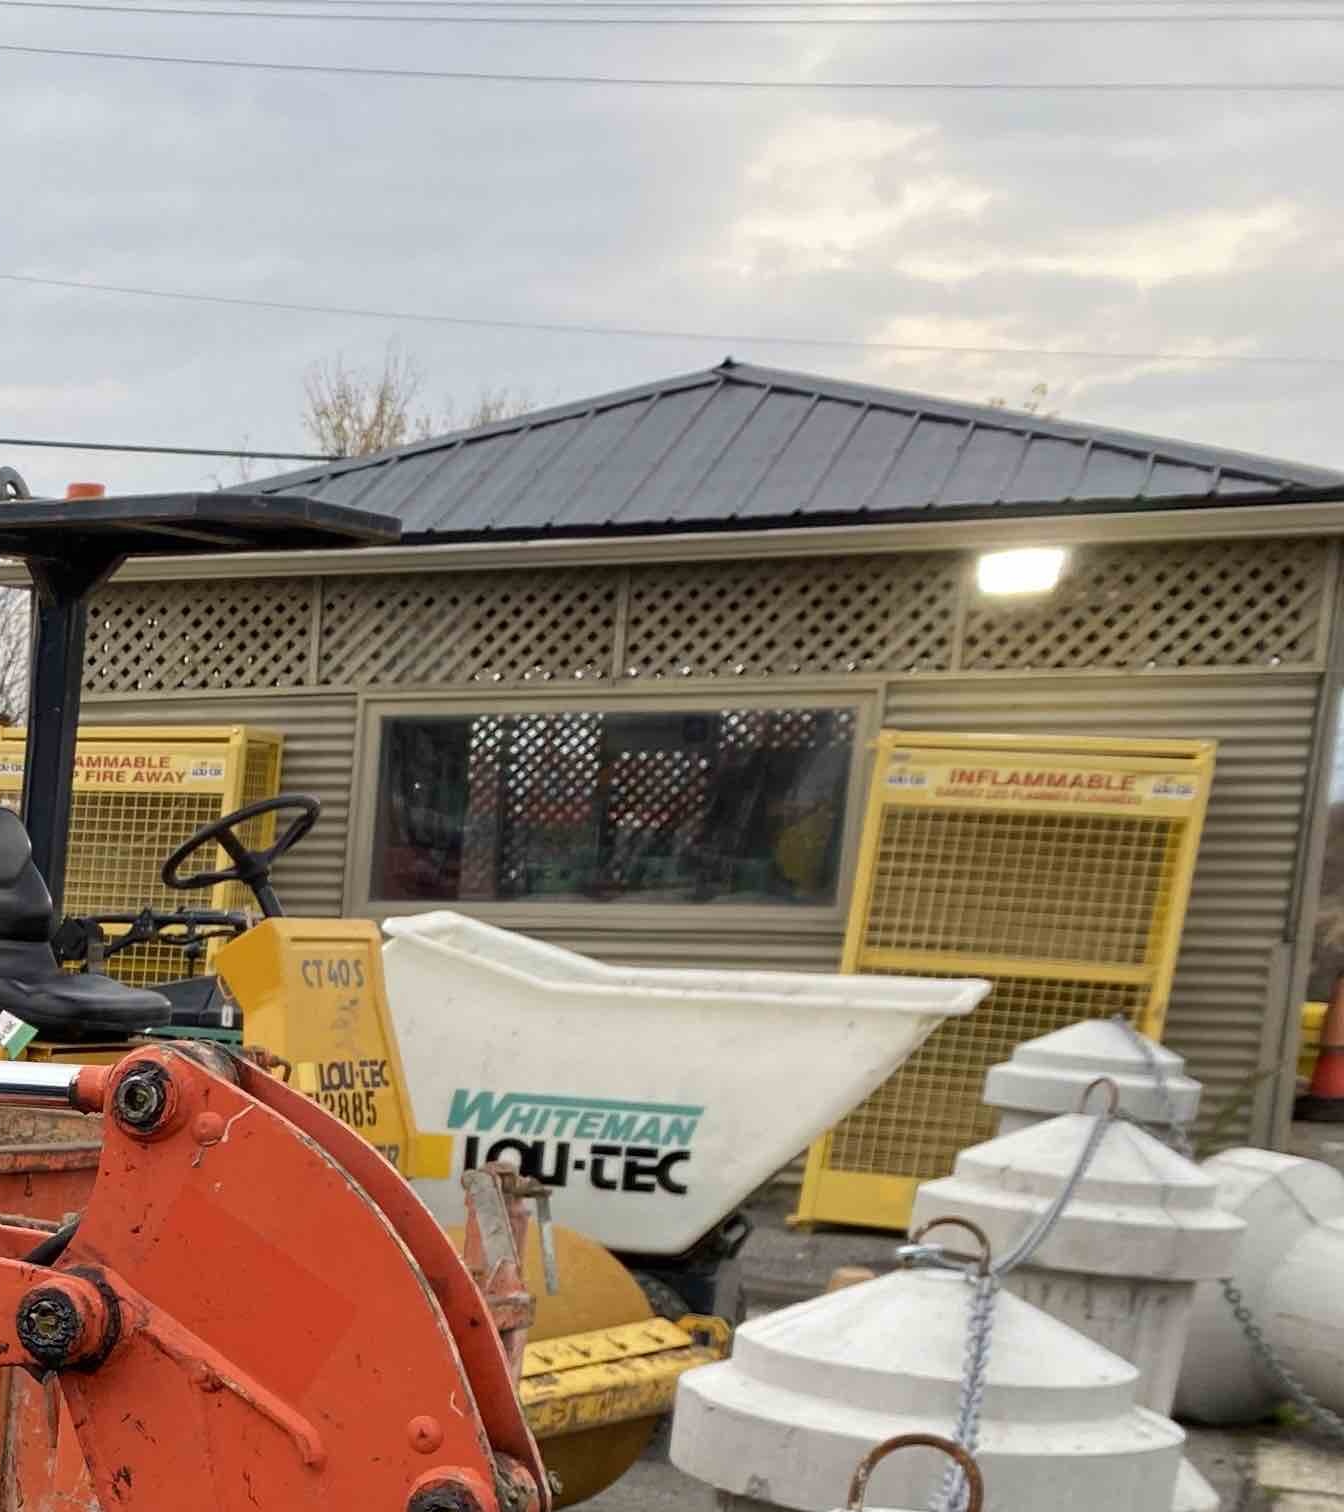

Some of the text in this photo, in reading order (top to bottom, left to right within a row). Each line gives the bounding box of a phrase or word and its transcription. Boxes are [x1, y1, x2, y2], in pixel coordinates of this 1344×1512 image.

[85, 771, 126, 783] FIRE
[131, 772, 186, 785] AWAY
[949, 767, 1137, 791] INFLAMMABLE
[317, 1058, 391, 1091] LOU-TEC
[463, 1136, 692, 1195] LOU-TEC
